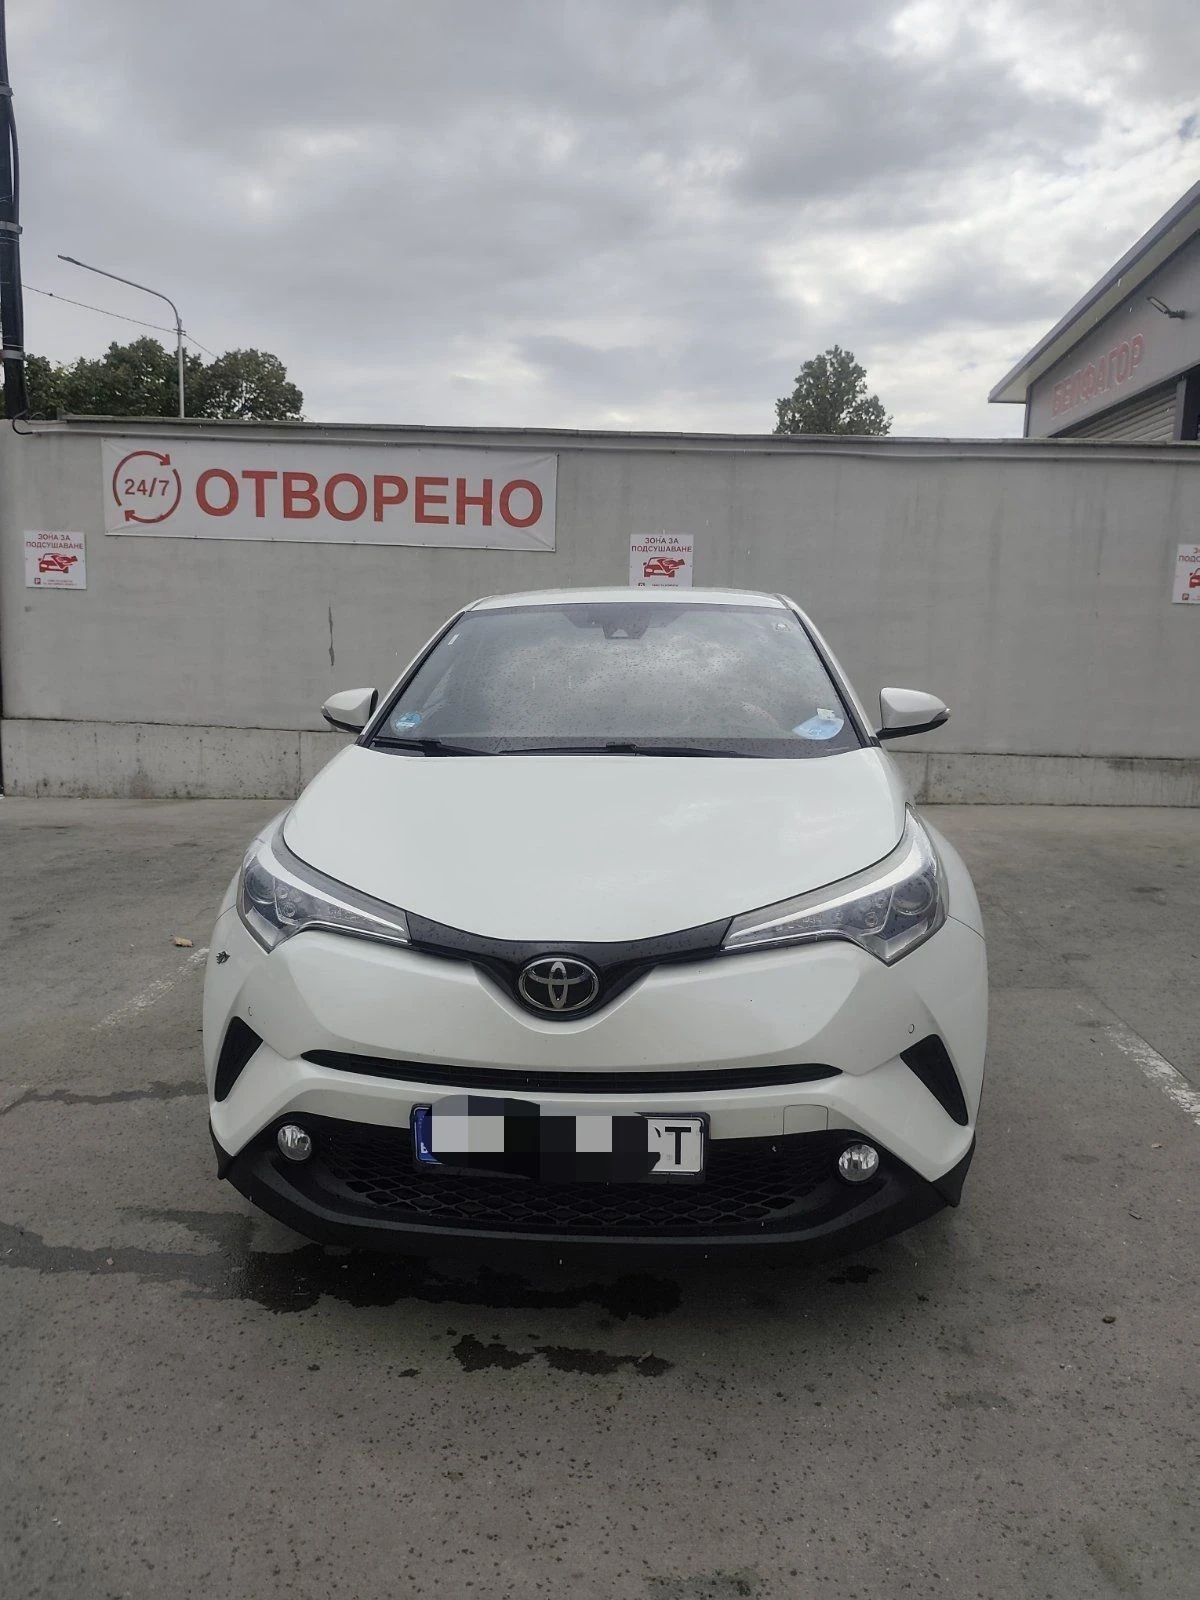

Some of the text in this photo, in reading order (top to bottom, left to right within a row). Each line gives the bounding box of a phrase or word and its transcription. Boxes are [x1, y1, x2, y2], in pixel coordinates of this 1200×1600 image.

[124, 477, 170, 497] 24/7
[196, 468, 543, 528] ОТВОРЕНО
[38, 533, 59, 541] ЗОНА
[26, 541, 84, 550] ПОДСУШАВАНЕ
[631, 545, 693, 553] ПОДСУШАВАНЕ
